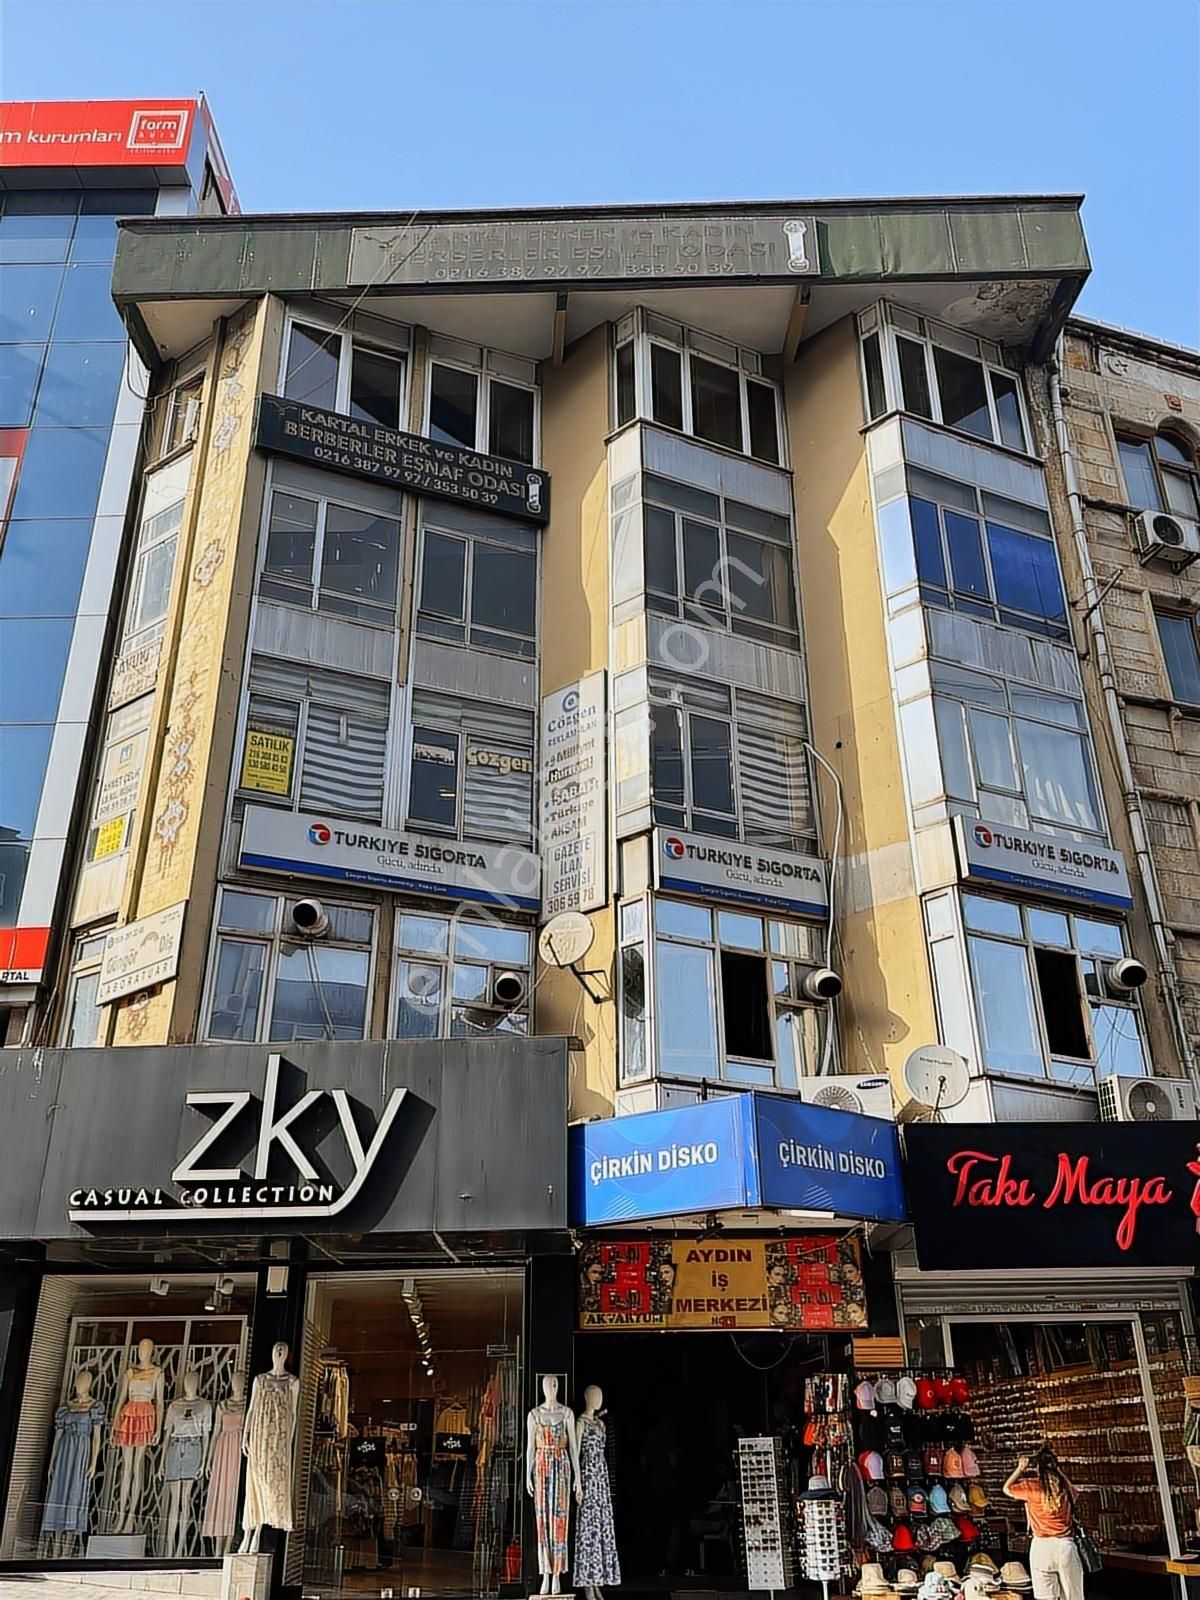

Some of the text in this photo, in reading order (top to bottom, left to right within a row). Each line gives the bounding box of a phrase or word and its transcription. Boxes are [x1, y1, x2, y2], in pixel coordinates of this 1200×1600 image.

[27, 129, 122, 143] kurumları
[140, 119, 177, 131] form
[301, 408, 513, 478] KARTAL ERKEK ve KADIN
[285, 420, 526, 499] BERBERLER ESNAF ODASI
[314, 446, 350, 465] 0216
[353, 457, 380, 473] 387
[383, 465, 400, 479] 97
[404, 471, 421, 484] 97
[433, 479, 459, 494] 353
[462, 486, 479, 499] 50
[481, 491, 498, 504] 39
[250, 735, 290, 752] SATILIK
[554, 837, 591, 861] GAZETE
[567, 891, 580, 908] 59
[590, 1141, 718, 1186] ÇİRKİN DİSKO
[778, 1138, 886, 1180] ÇİRKİN DİSKO
[69, 1185, 334, 1207] CASUAL COLLECTION
[1043, 1152, 1173, 1251] Maya
[685, 1248, 752, 1264] AYDIN
[711, 1269, 729, 1293] İŞ
[675, 1292, 769, 1313] MERKEZİ
